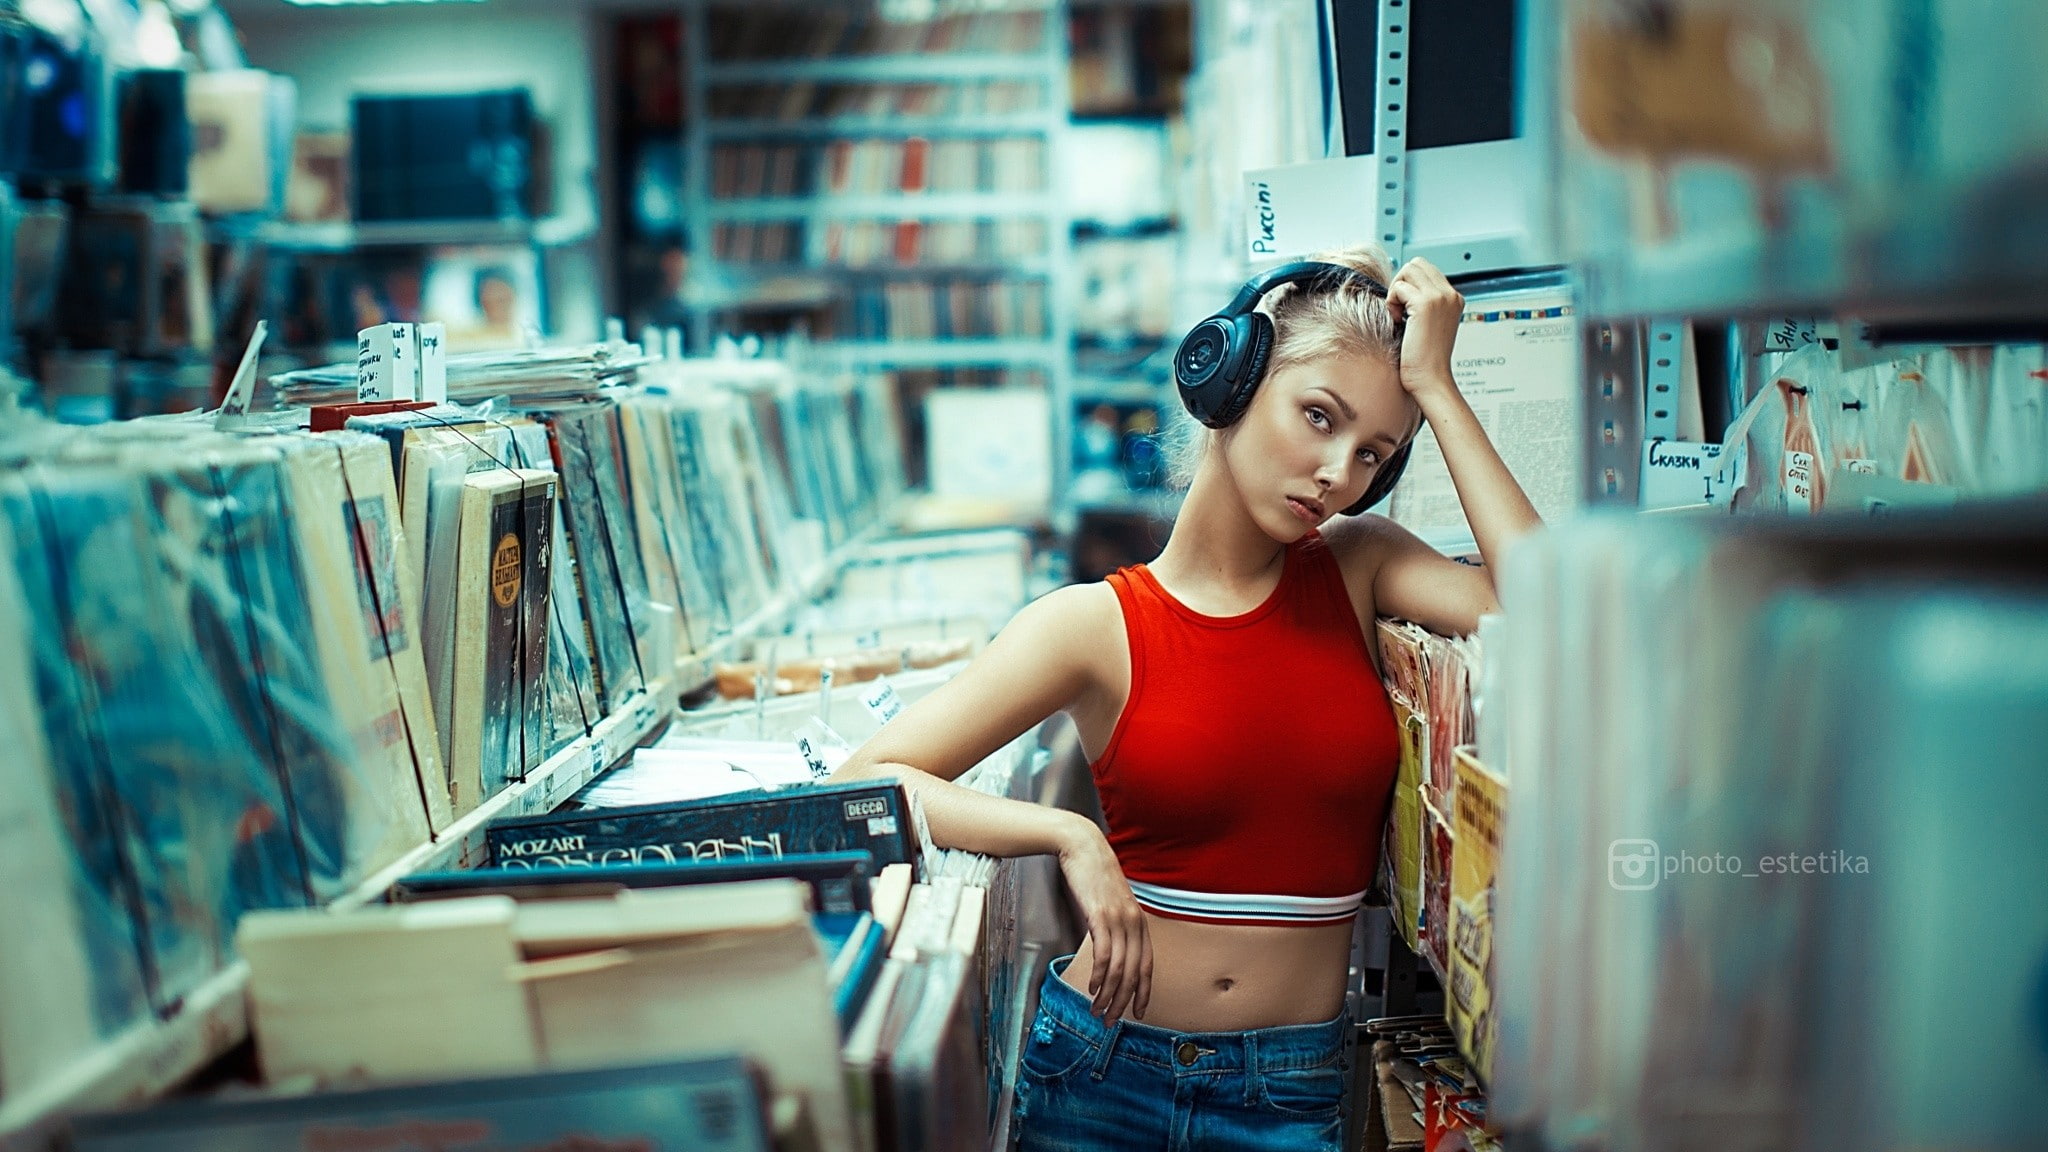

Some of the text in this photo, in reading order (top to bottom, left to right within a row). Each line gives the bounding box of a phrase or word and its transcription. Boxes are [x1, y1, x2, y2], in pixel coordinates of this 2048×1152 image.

[1252, 182, 1276, 253] Puccini
[847, 801, 884, 816] DECCA
[500, 835, 587, 858] MOZART
